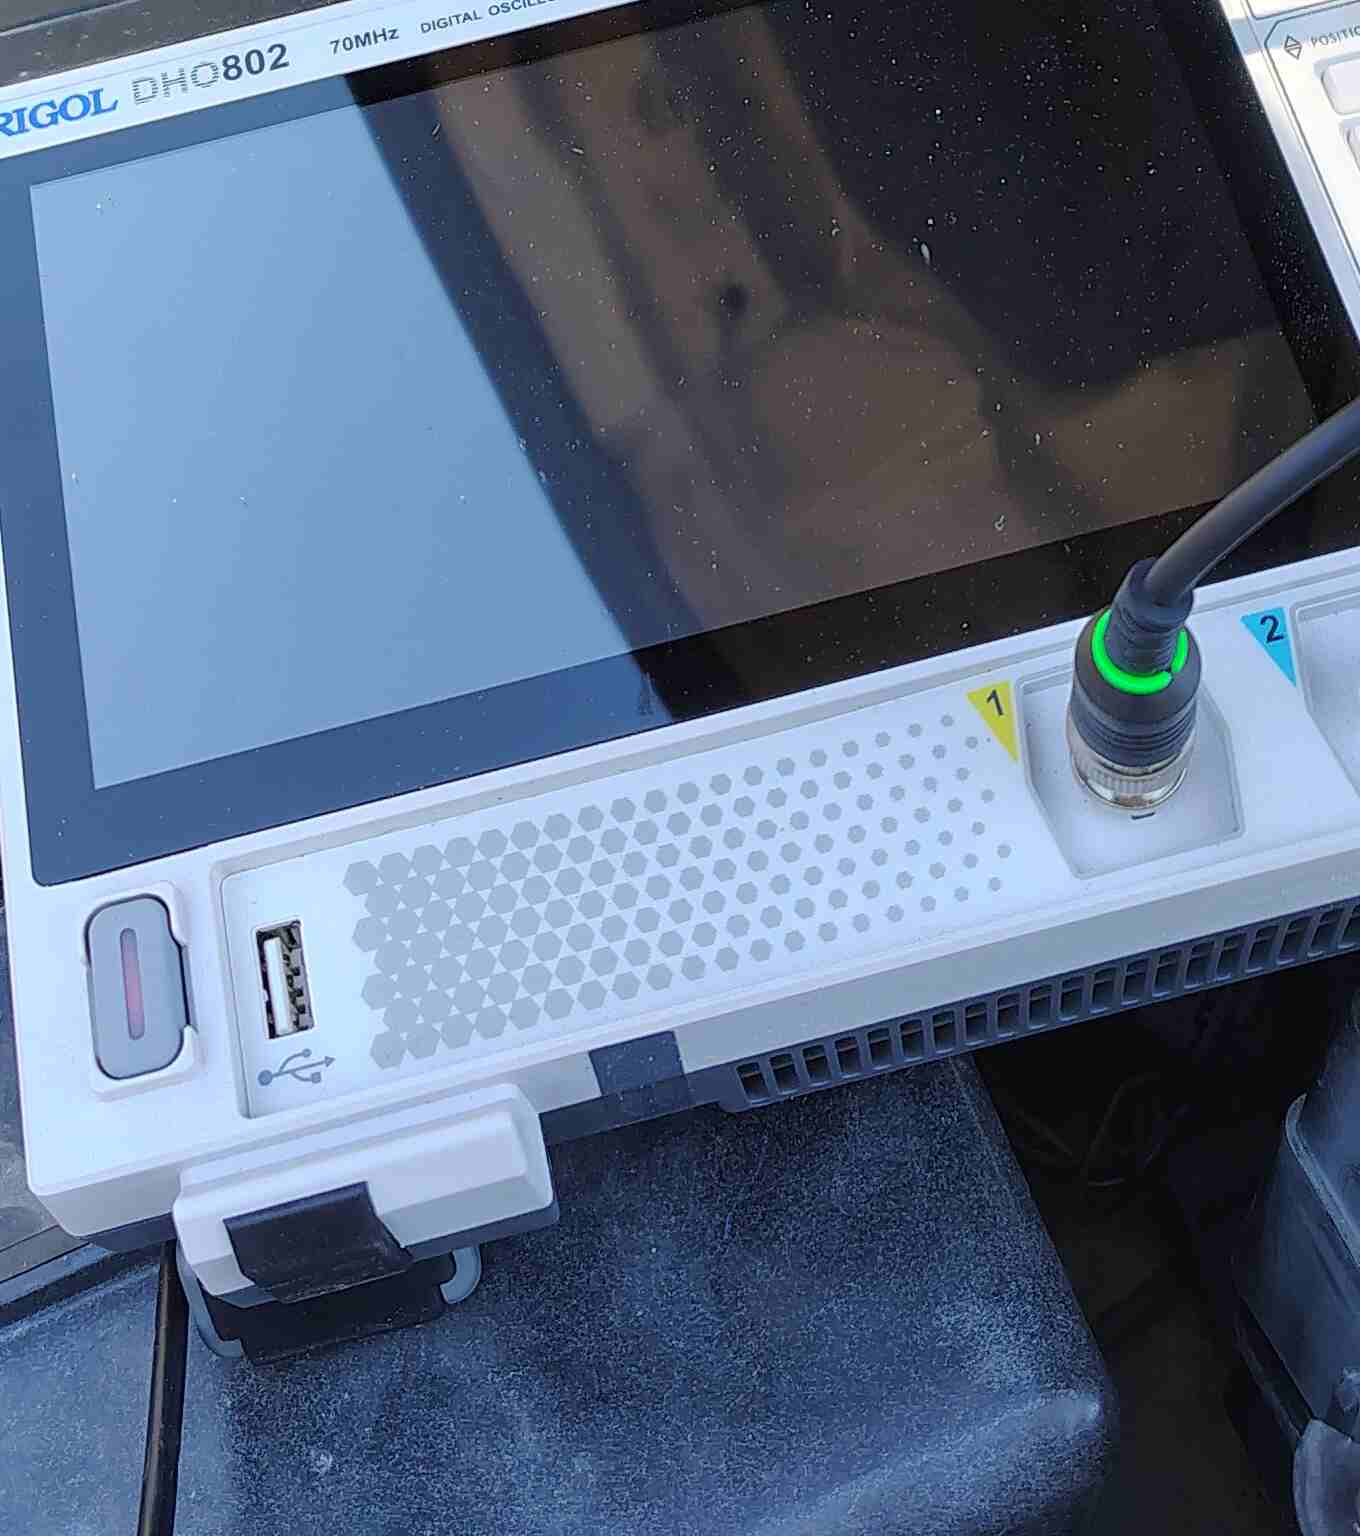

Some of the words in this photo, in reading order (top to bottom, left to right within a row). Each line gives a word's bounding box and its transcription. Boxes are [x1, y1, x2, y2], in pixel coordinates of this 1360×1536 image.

[329, 27, 399, 55] 70MHz
[420, 9, 482, 34] DIGITAL
[132, 43, 290, 106] DHO802
[1260, 615, 1285, 644] 2
[986, 689, 1005, 717] 1
